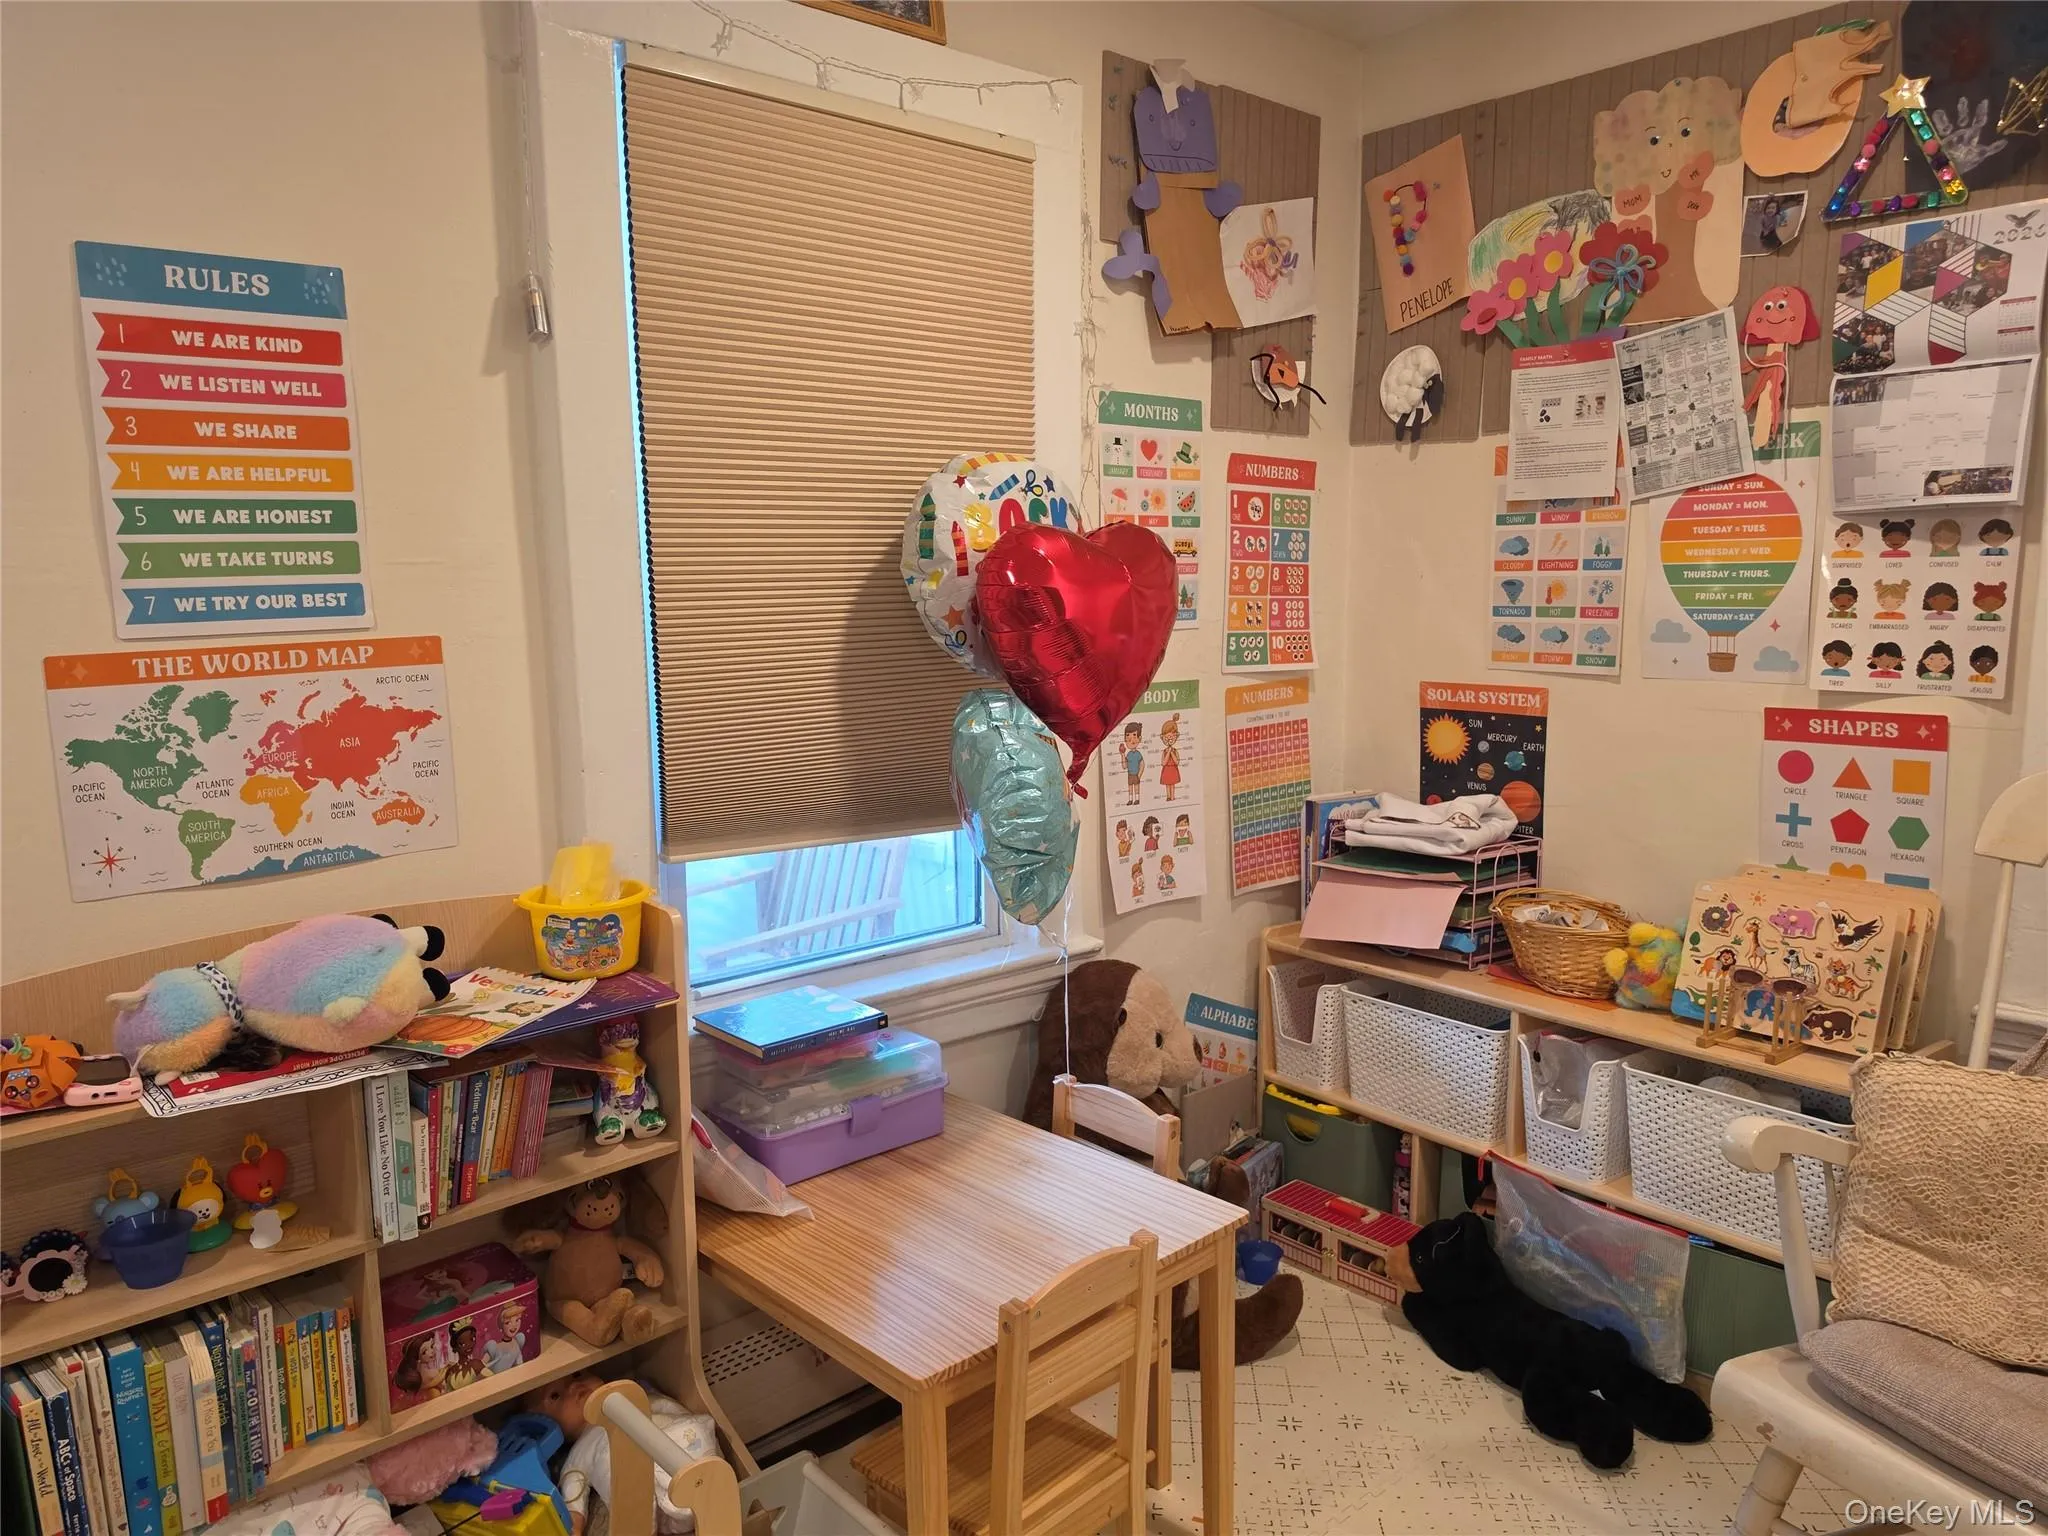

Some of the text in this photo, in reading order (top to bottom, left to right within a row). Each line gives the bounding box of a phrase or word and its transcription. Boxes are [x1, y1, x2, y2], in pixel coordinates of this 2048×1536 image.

[164, 265, 270, 296] RULES
[1400, 278, 1453, 322] PENELOPE
[172, 330, 205, 347] WE
[211, 335, 250, 350] ARE
[255, 338, 303, 354] KIND
[121, 369, 322, 397] 2 WE LISTEN WELL
[1124, 402, 1179, 422] MONTHS
[126, 416, 297, 440] 3 WE SHARE
[131, 461, 331, 483] 4 WE ARE HELPFUL
[1245, 463, 1299, 481] NUMBERS
[1743, 481, 1765, 489] SUN.
[1233, 494, 1238, 508] 1
[1274, 497, 1280, 511] 6
[1693, 501, 1768, 511] MONDAY MON.
[135, 506, 332, 526] 5 WE ARE HONEST
[1504, 515, 1526, 524] SUNNY
[1550, 513, 1570, 522] WINDY
[1693, 524, 1766, 533] TUESDAY TUES.
[1232, 530, 1240, 544] 2
[1273, 532, 1280, 546] 7
[1685, 548, 1740, 556] WEDNESDAY
[141, 551, 335, 571] 6 WE TAKE TURNS
[1502, 561, 1524, 570] CLOUDY
[1541, 561, 1574, 569] LIGHTNING
[1592, 560, 1612, 569] FOGGY
[1232, 566, 1239, 580] 3
[1273, 567, 1280, 581] 8
[144, 592, 348, 616] 7 WE TRY OUR BEST
[1231, 601, 1237, 615] 4
[1272, 602, 1279, 615] 9
[1498, 608, 1526, 616] TORNADO
[1549, 608, 1561, 616] HOT
[1585, 609, 1613, 617] FREEZING
[1229, 637, 1236, 650] 5
[1271, 636, 1284, 649] 10
[132, 646, 375, 679] THE WORLD MAP
[1541, 655, 1565, 663] STORMY
[1585, 656, 1607, 665] SNOWY
[375, 673, 429, 685] ARCTIC OCEAN
[1144, 688, 1179, 704] BODY
[1243, 686, 1294, 705] NUMBERS
[1427, 688, 1541, 708] SOLAR SYSTEM
[1468, 719, 1483, 729] SUN
[1808, 718, 1899, 738] SHAPES
[339, 736, 361, 748] ASIA
[1487, 733, 1517, 743] MERCURY
[1523, 742, 1544, 752] EARTH
[262, 750, 298, 763] EUROPE
[412, 759, 440, 770] PACIFIC
[132, 765, 168, 778] NORTH
[414, 768, 439, 778] OCEAN
[72, 782, 106, 794] PACIFIC
[130, 776, 174, 790] AMERICA
[195, 778, 234, 791] ATLANTIC
[1467, 781, 1487, 791] VENUS
[75, 791, 106, 803] OCEAN
[202, 787, 230, 799] OCEAN
[256, 786, 290, 799] AFRICA
[1783, 787, 1807, 795] CIRCLE
[1835, 791, 1868, 801] TRIANGLE
[330, 800, 354, 811] INDIAN
[1896, 797, 1925, 806] SQUARE
[330, 808, 356, 820] OCEAN
[375, 806, 422, 821] AUSTRALIA
[187, 820, 221, 832] SOUTH
[1514, 825, 1534, 835] PITER
[184, 830, 227, 843] AMERICA
[253, 836, 323, 854] SOUTHERN OCEAN
[1781, 840, 1804, 848] CROSS
[1830, 846, 1867, 856] PENTAGON
[303, 849, 355, 867] ANTARTICA
[1891, 853, 1925, 863] HEXAGON
[468, 972, 576, 1000] Vegetables
[1200, 1005, 1257, 1031] ALPHABE
[376, 1091, 386, 1114] Love
[471, 1080, 483, 1134] Bedtime Bear
[378, 1115, 389, 1134] You
[379, 1135, 390, 1155] Like
[381, 1156, 390, 1170] No
[419, 1148, 427, 1167] Hungry
[382, 1172, 391, 1196] Otter
[203, 1408, 215, 1424] Kiss
[148, 1370, 170, 1438] LLAMASTE
[160, 1450, 173, 1478] Friends
[247, 1388, 264, 1464] COUNTING!
[57, 1438, 72, 1465] ABCs
[206, 1439, 217, 1453] You
[63, 1473, 77, 1502] Space
